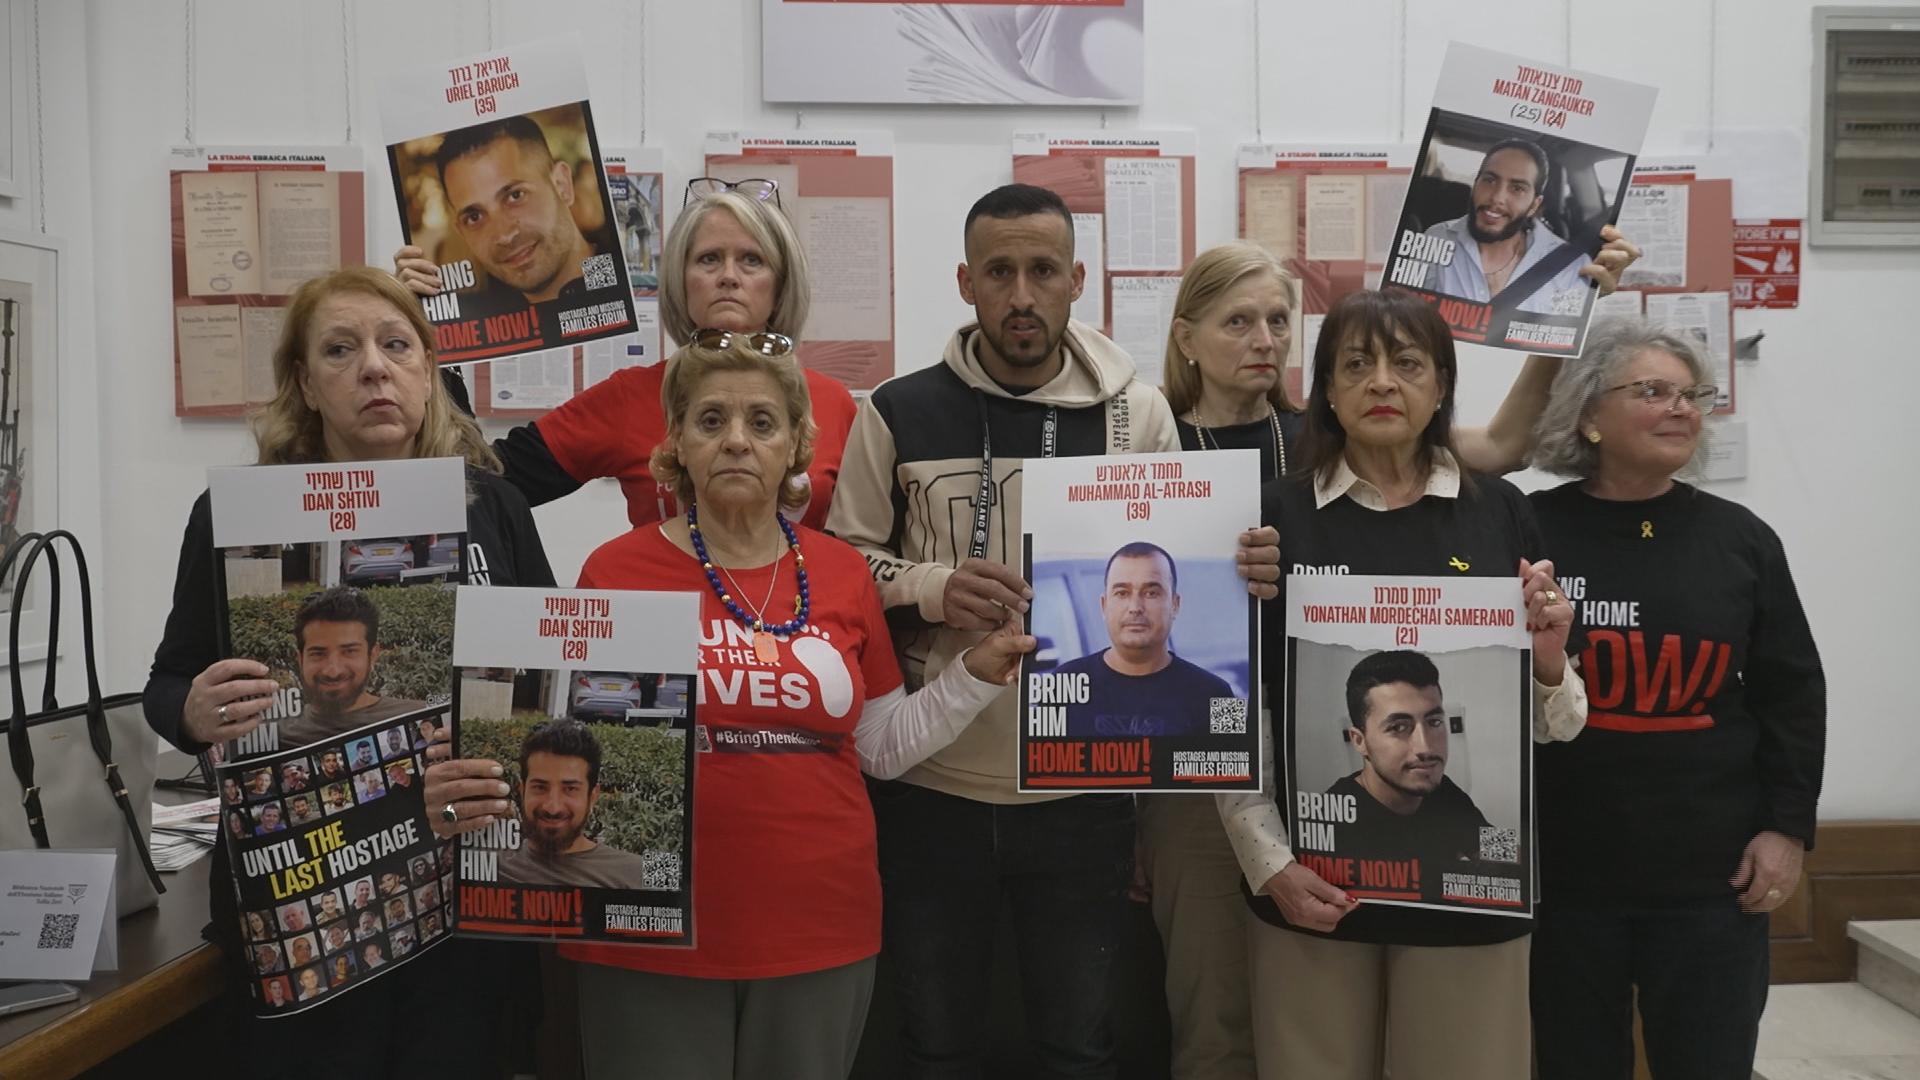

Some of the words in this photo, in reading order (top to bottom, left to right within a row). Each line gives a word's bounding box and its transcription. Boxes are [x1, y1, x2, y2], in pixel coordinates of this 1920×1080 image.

[448, 66, 472, 85] ברוך
[473, 56, 511, 78] אוריאל
[445, 83, 476, 103] URIEL
[476, 72, 520, 96] BARUCH
[1560, 76, 1583, 95] מתן
[474, 95, 496, 116] (35)
[1492, 78, 1532, 101] MATAN
[1531, 88, 1595, 116] ZANGAUKER
[1510, 102, 1542, 124] (25)
[1398, 230, 1456, 266] BRING
[1390, 256, 1430, 288] HIM
[422, 292, 460, 322] HIM
[558, 306, 588, 321] HOSTAGES
[588, 304, 600, 316] AND
[600, 300, 625, 312] MISSING
[1440, 300, 1492, 332] NOW!
[484, 304, 540, 344] NOW!
[560, 316, 598, 335] FAMILIES
[598, 309, 628, 328] FORUM
[346, 470, 374, 490] עידן
[982, 463, 990, 488] ICON
[1096, 463, 1147, 482] אלאטרש
[1150, 462, 1182, 480] מחמד
[302, 492, 334, 512] IDAN
[338, 490, 380, 510] SHTIVI
[1068, 483, 1140, 502] MUHAMMAD
[1143, 480, 1211, 500] AL-ATRASH
[978, 489, 990, 528] MILANO
[1126, 500, 1151, 521] (39)
[330, 510, 356, 532] (28)
[1374, 586, 1409, 605] סמרנו
[1412, 587, 1442, 606] יונתן
[583, 598, 610, 619] עידן
[1303, 605, 1366, 624] YONATHAN
[1370, 607, 1441, 626] MORDECHAI
[1444, 608, 1515, 627] SAMERANO
[1582, 601, 1640, 626] HOME
[538, 618, 568, 638] IDAN
[572, 619, 613, 640] SHTIVI
[698, 618, 754, 648] UN
[1396, 626, 1418, 646] (21)
[562, 639, 588, 662] (28)
[712, 648, 781, 667] THE
[697, 668, 812, 710] IVES
[1028, 672, 1090, 704] BRING
[1028, 706, 1067, 737] HIM
[237, 722, 279, 756] HIM
[1028, 742, 1086, 773] HOME
[1091, 738, 1152, 773] NOW!
[1173, 752, 1206, 762] HOSTAGES
[1206, 752, 1220, 762] AND
[1220, 752, 1250, 762] MISSING
[1173, 762, 1215, 778] FAMILIES
[1216, 762, 1250, 778] FORUM
[1297, 791, 1358, 824] BRING
[460, 818, 522, 850] BRING
[1298, 821, 1336, 853] HIM
[242, 838, 306, 878] UNTIL
[304, 820, 348, 858] THE
[269, 858, 326, 900] LAST
[327, 818, 420, 879] HOSTAGE
[460, 850, 498, 882] HIM
[1360, 858, 1421, 889] NOW!
[1442, 873, 1476, 886] HOSTAGES
[1476, 875, 1490, 886] AND
[1491, 877, 1521, 889] MISSING
[1442, 882, 1486, 899] FAMILIES
[1486, 886, 1521, 904] FORUM
[460, 885, 518, 920] HOME
[522, 888, 584, 924] NOW!
[605, 904, 638, 917] HOSTAGES
[638, 905, 652, 918] AND
[653, 906, 682, 918] MISSING
[605, 914, 648, 932] FAMILIES
[649, 916, 684, 934] FORUM
